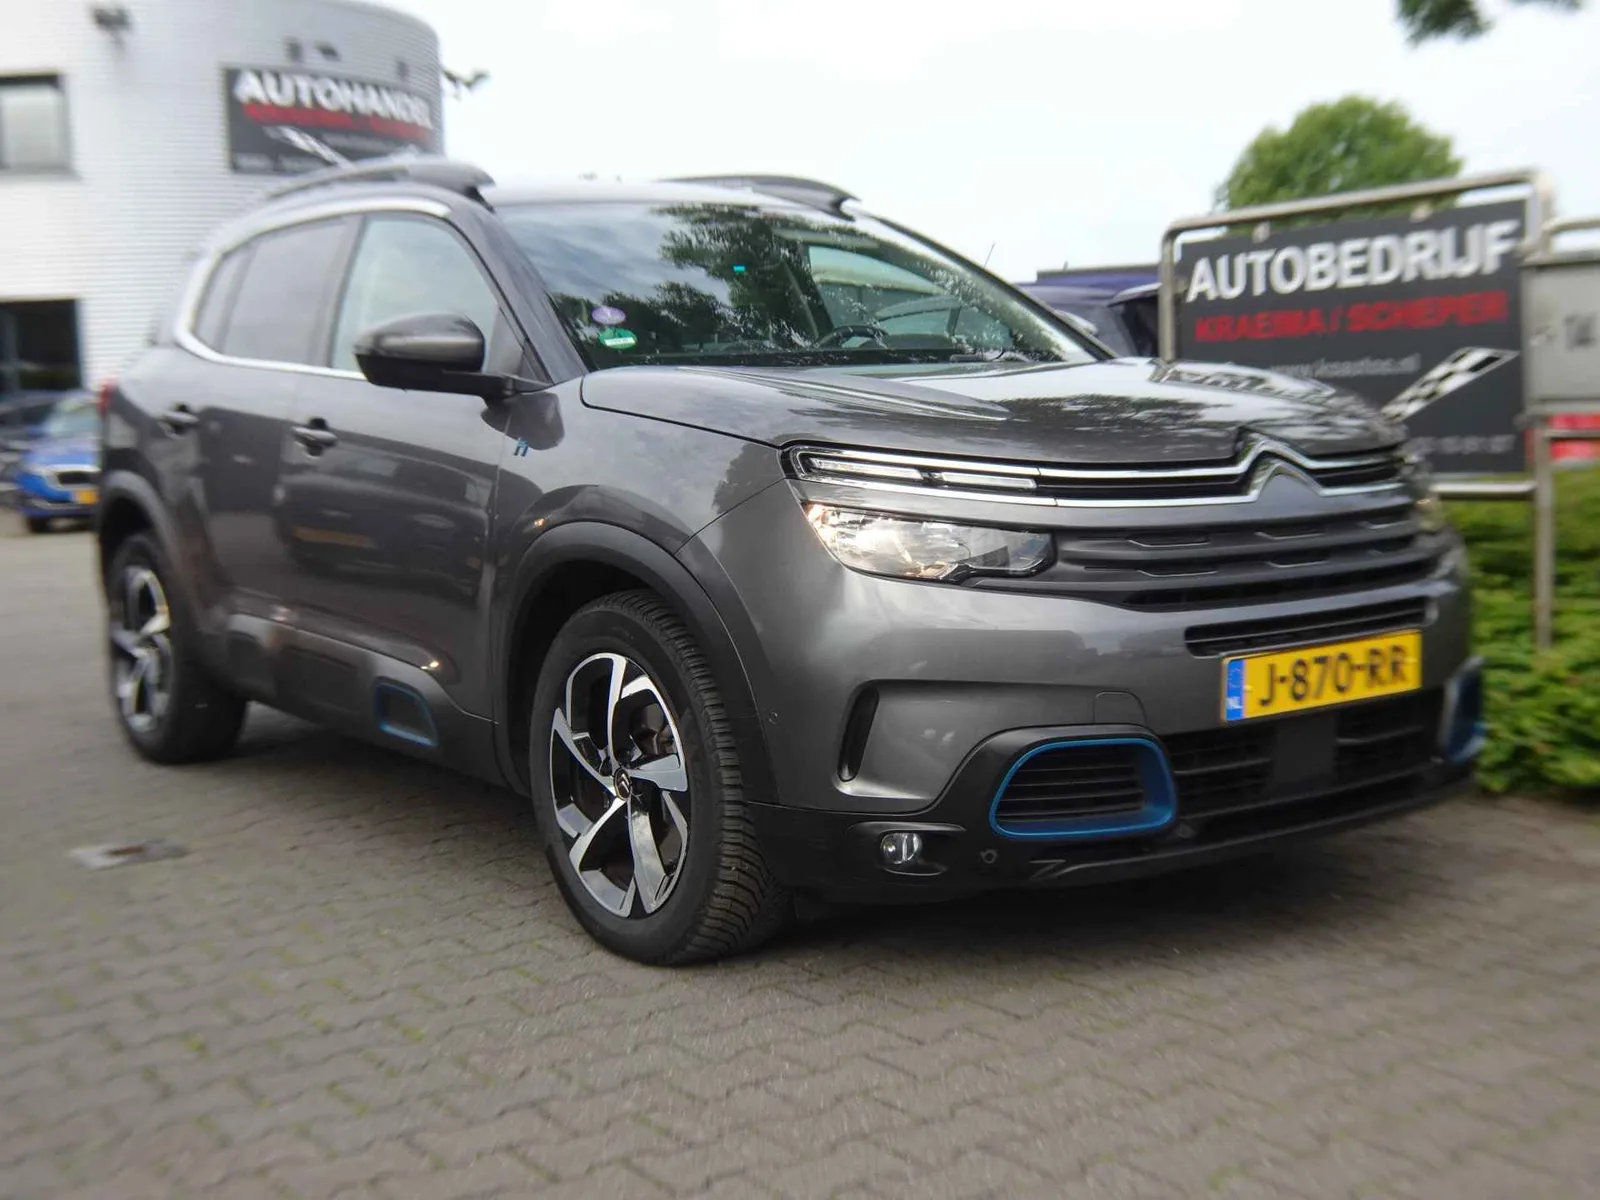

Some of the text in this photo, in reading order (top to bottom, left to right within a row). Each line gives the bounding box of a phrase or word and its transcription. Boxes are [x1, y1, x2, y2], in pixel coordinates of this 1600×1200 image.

[234, 70, 432, 130] AUTOHANDEL
[1186, 218, 1521, 303] AUTOBEDRIJF
[1345, 290, 1508, 331] SCHEPER
[1259, 645, 1408, 707] J-870-RR
